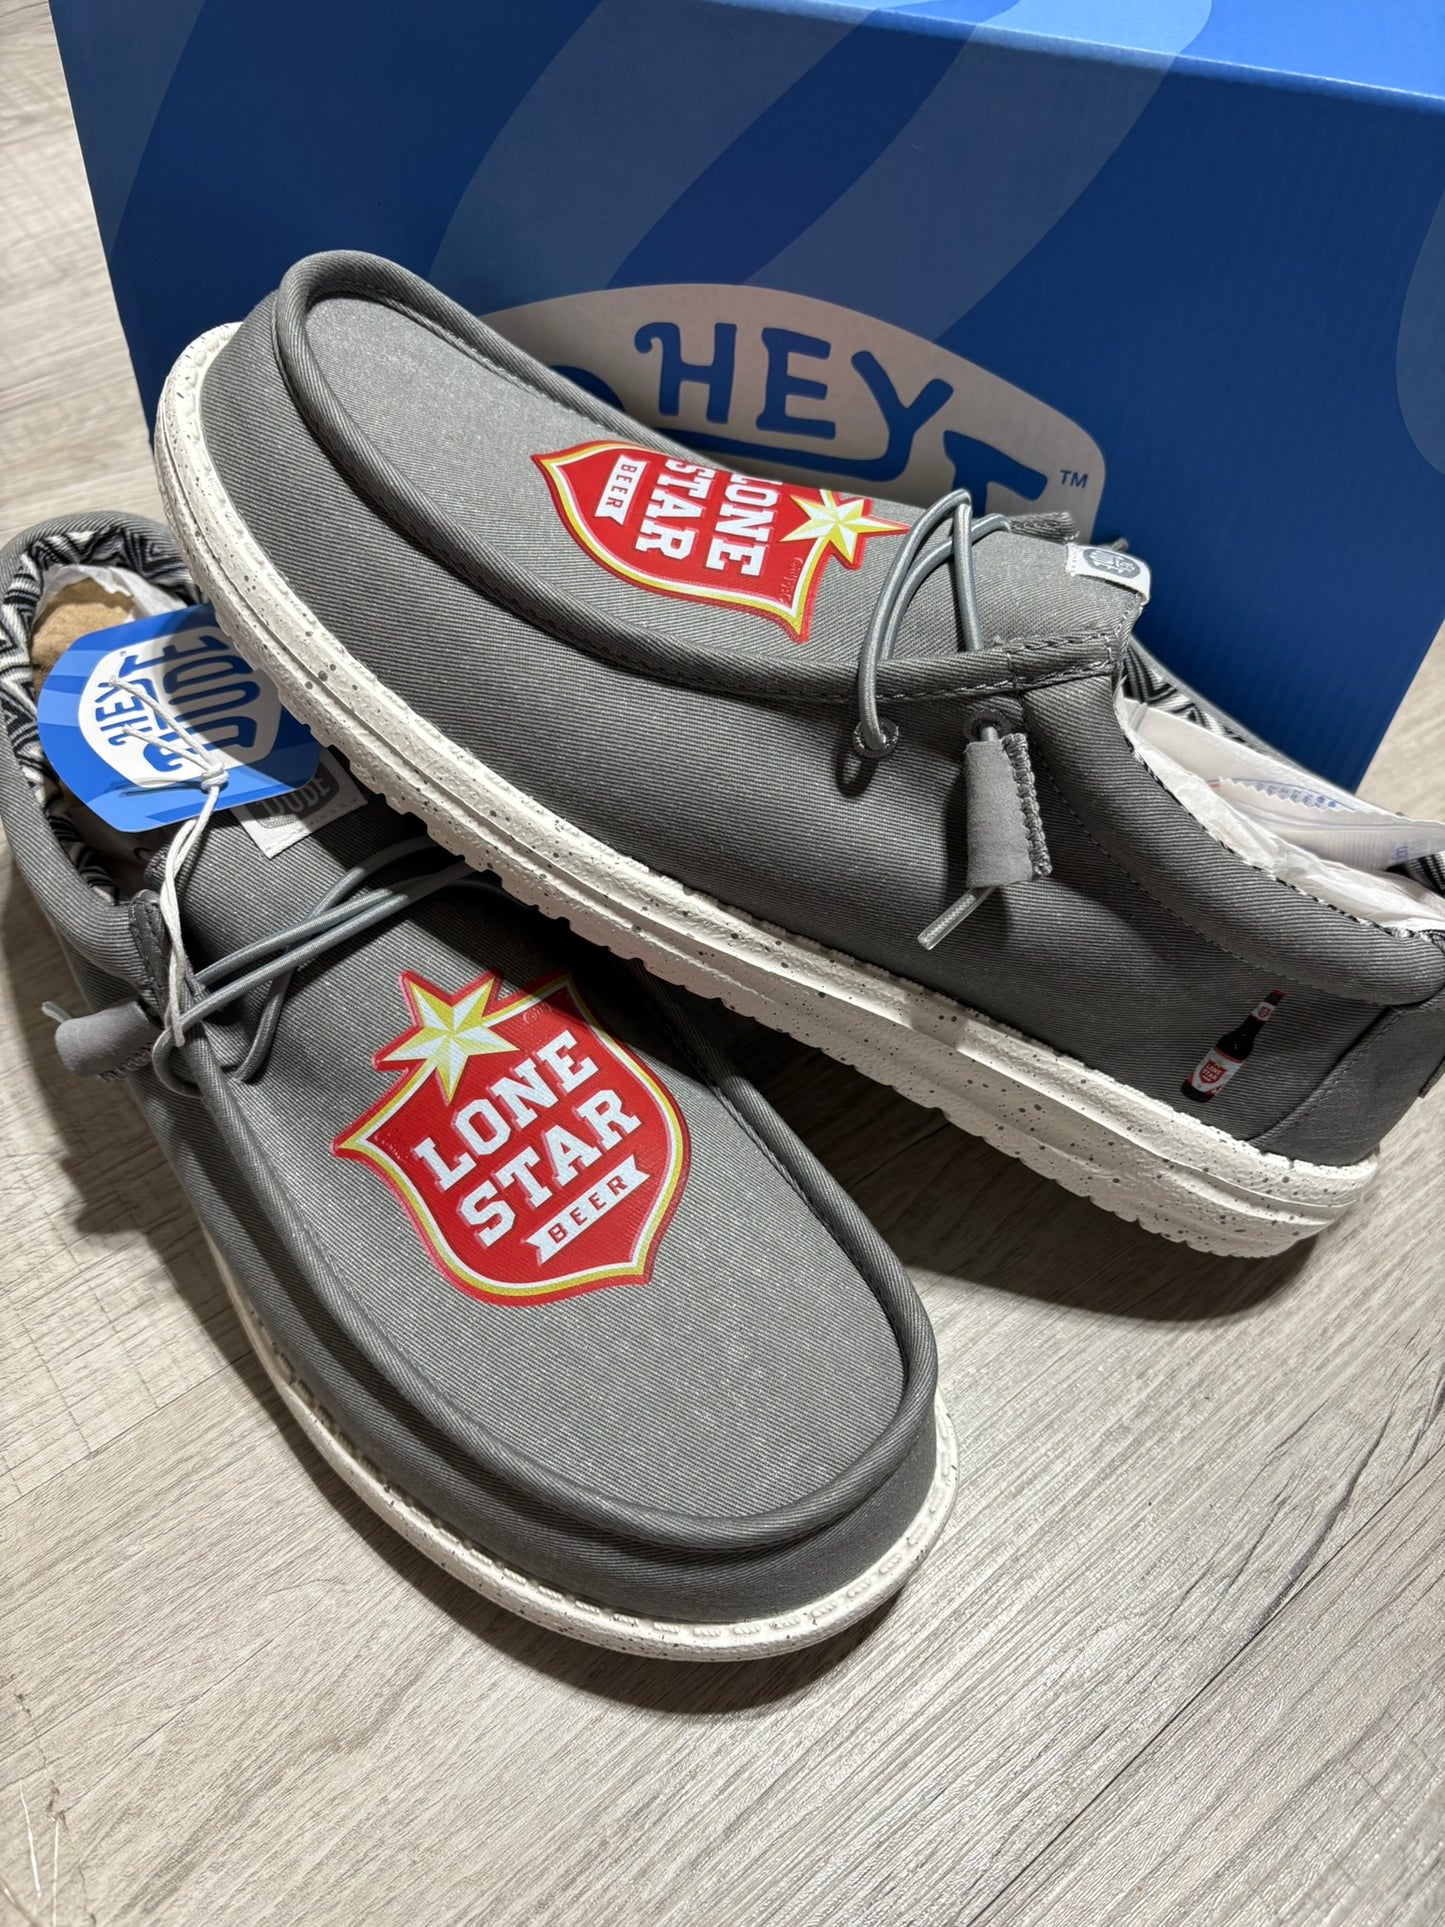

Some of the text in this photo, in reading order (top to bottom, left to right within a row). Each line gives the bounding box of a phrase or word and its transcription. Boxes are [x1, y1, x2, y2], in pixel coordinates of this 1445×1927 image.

[634, 321, 953, 481] HEY
[612, 463, 637, 509] BEER
[635, 459, 716, 561] STAR
[1060, 470, 1088, 488] TM
[95, 678, 169, 746] HEY
[119, 635, 260, 772] DUDE
[414, 1028, 600, 1193] LONE
[458, 1089, 642, 1249] STAR
[547, 1176, 629, 1244] BEER
